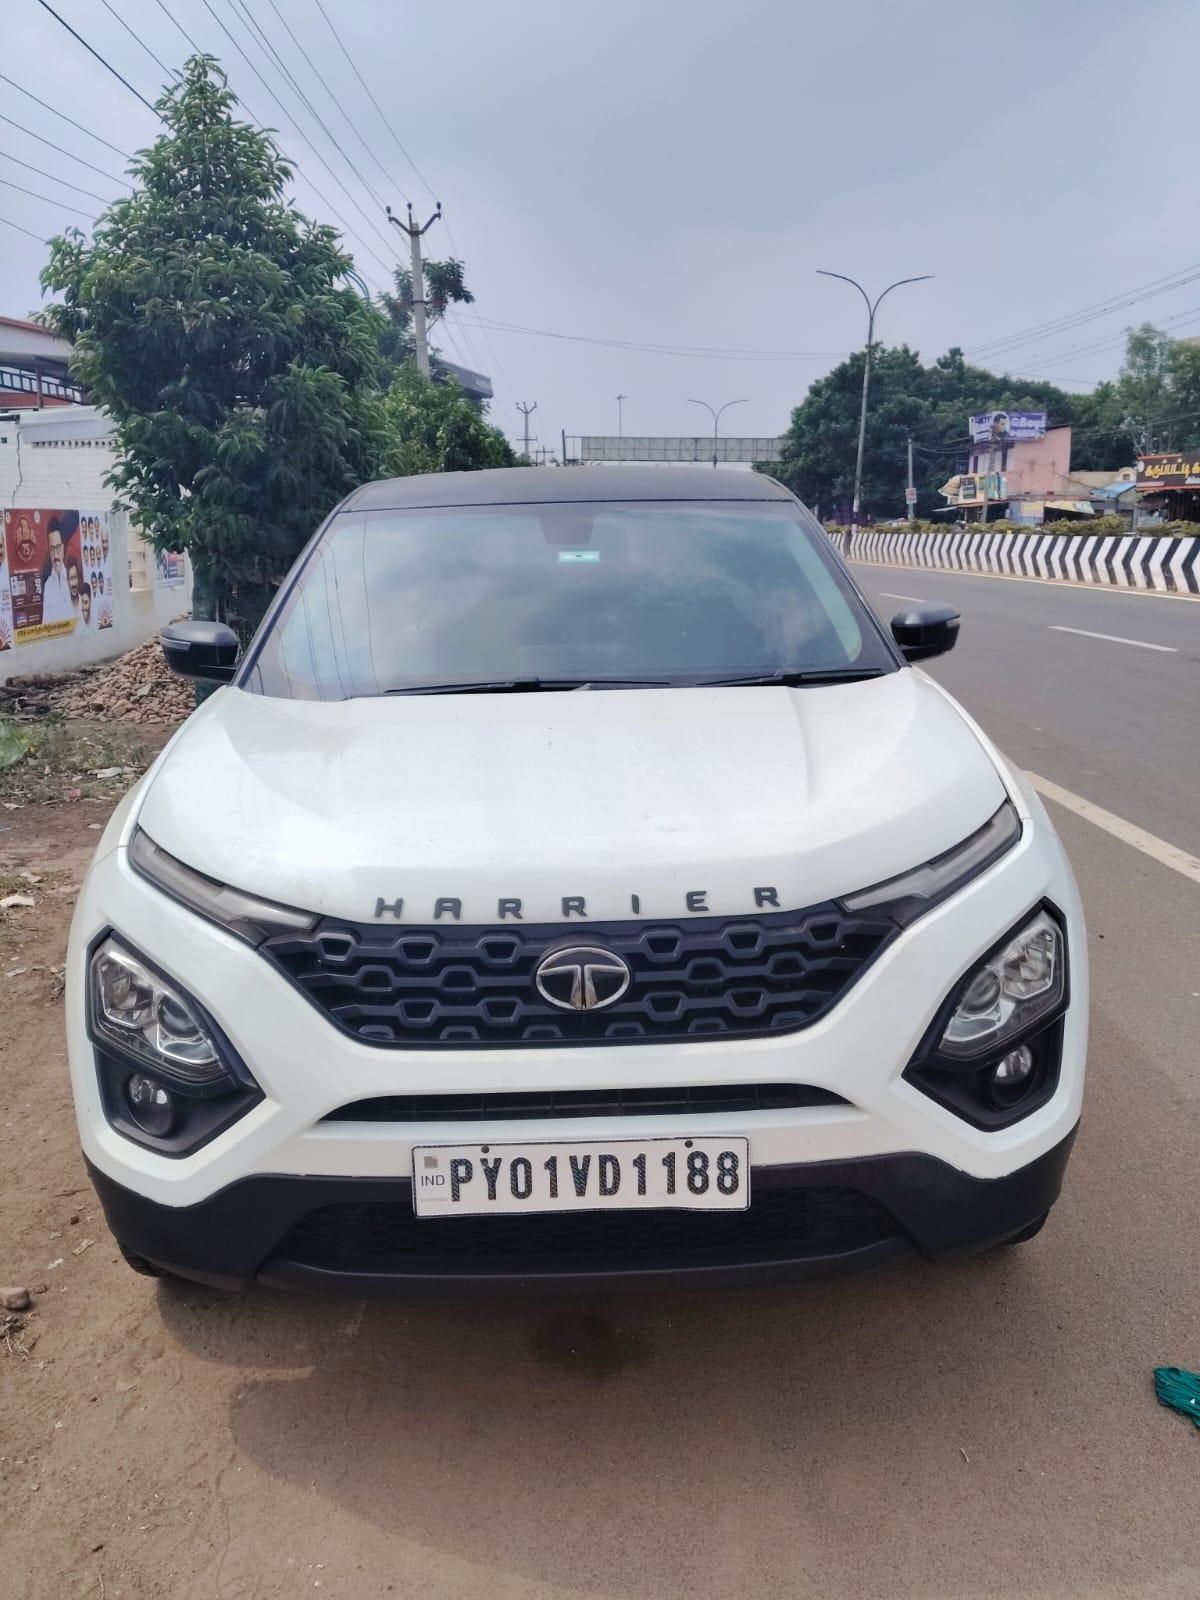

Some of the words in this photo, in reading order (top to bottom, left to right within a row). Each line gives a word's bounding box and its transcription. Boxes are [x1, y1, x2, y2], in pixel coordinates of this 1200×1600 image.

[374, 886, 781, 920] HARRIER
[421, 1174, 445, 1187] IND
[450, 1151, 739, 1202] PY01VD1188
